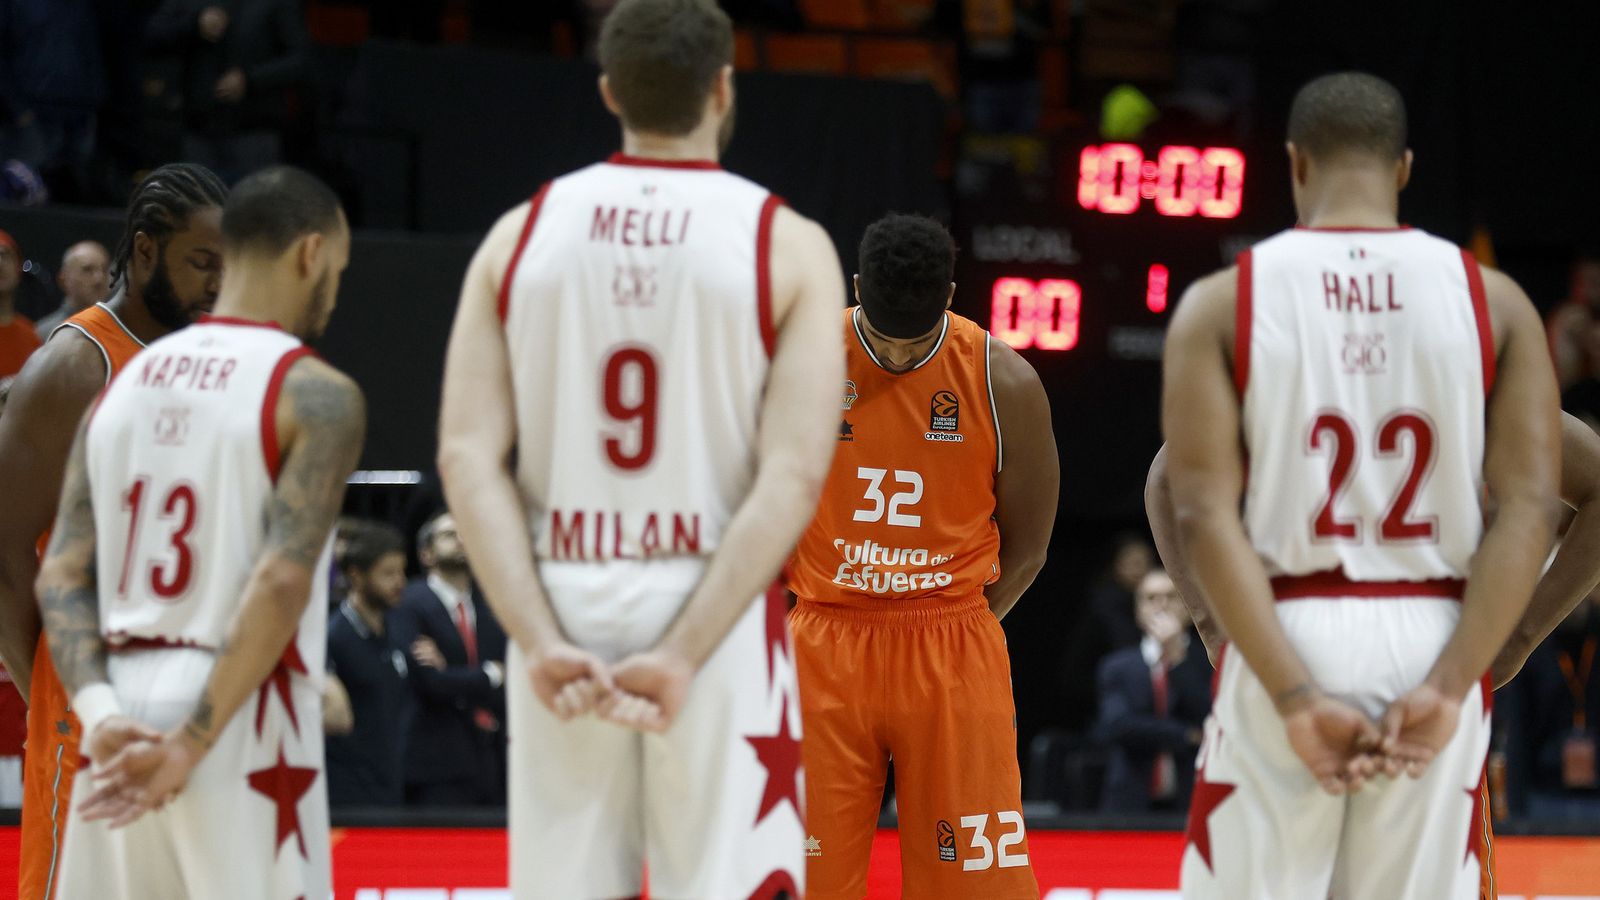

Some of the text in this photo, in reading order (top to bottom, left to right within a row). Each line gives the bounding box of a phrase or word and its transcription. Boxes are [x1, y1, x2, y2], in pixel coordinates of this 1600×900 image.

[1077, 143, 1246, 218] 10:00
[589, 205, 691, 247] MELLI
[990, 277, 1082, 351] 00
[1146, 263, 1169, 313] 1
[1322, 271, 1403, 313] HALL
[135, 355, 238, 391] NAPIER
[601, 345, 661, 475] 9
[852, 466, 924, 528] 32
[1307, 412, 1437, 543] 22
[117, 475, 198, 601] 13
[551, 510, 701, 561] MILAN
[832, 562, 953, 594] Esfuerzo
[960, 810, 1029, 872] 32
